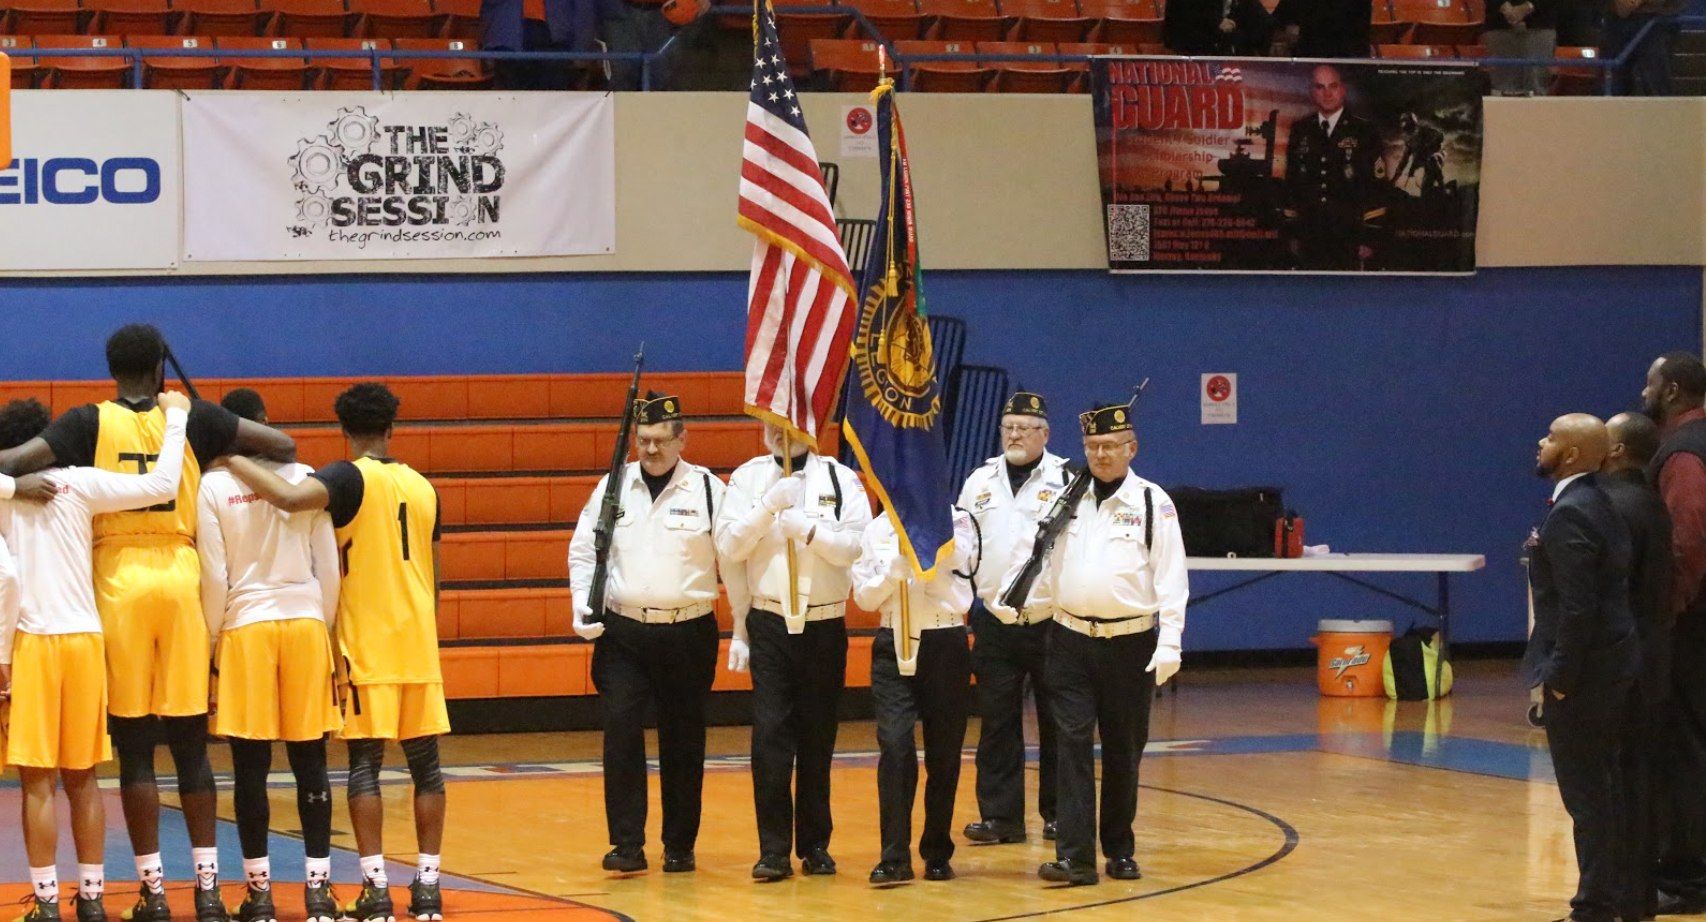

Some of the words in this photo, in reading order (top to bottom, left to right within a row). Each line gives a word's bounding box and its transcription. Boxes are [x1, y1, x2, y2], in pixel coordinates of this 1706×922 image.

[1109, 61, 1215, 85] NATIONAL
[1111, 83, 1245, 130] GUARD
[384, 125, 449, 154] THE
[1188, 133, 1230, 145] Soldier
[347, 153, 505, 195] GRIND
[328, 229, 501, 249] thegrindsession.com
[398, 502, 410, 560] 1
[1330, 655, 1369, 667] Gatorade
